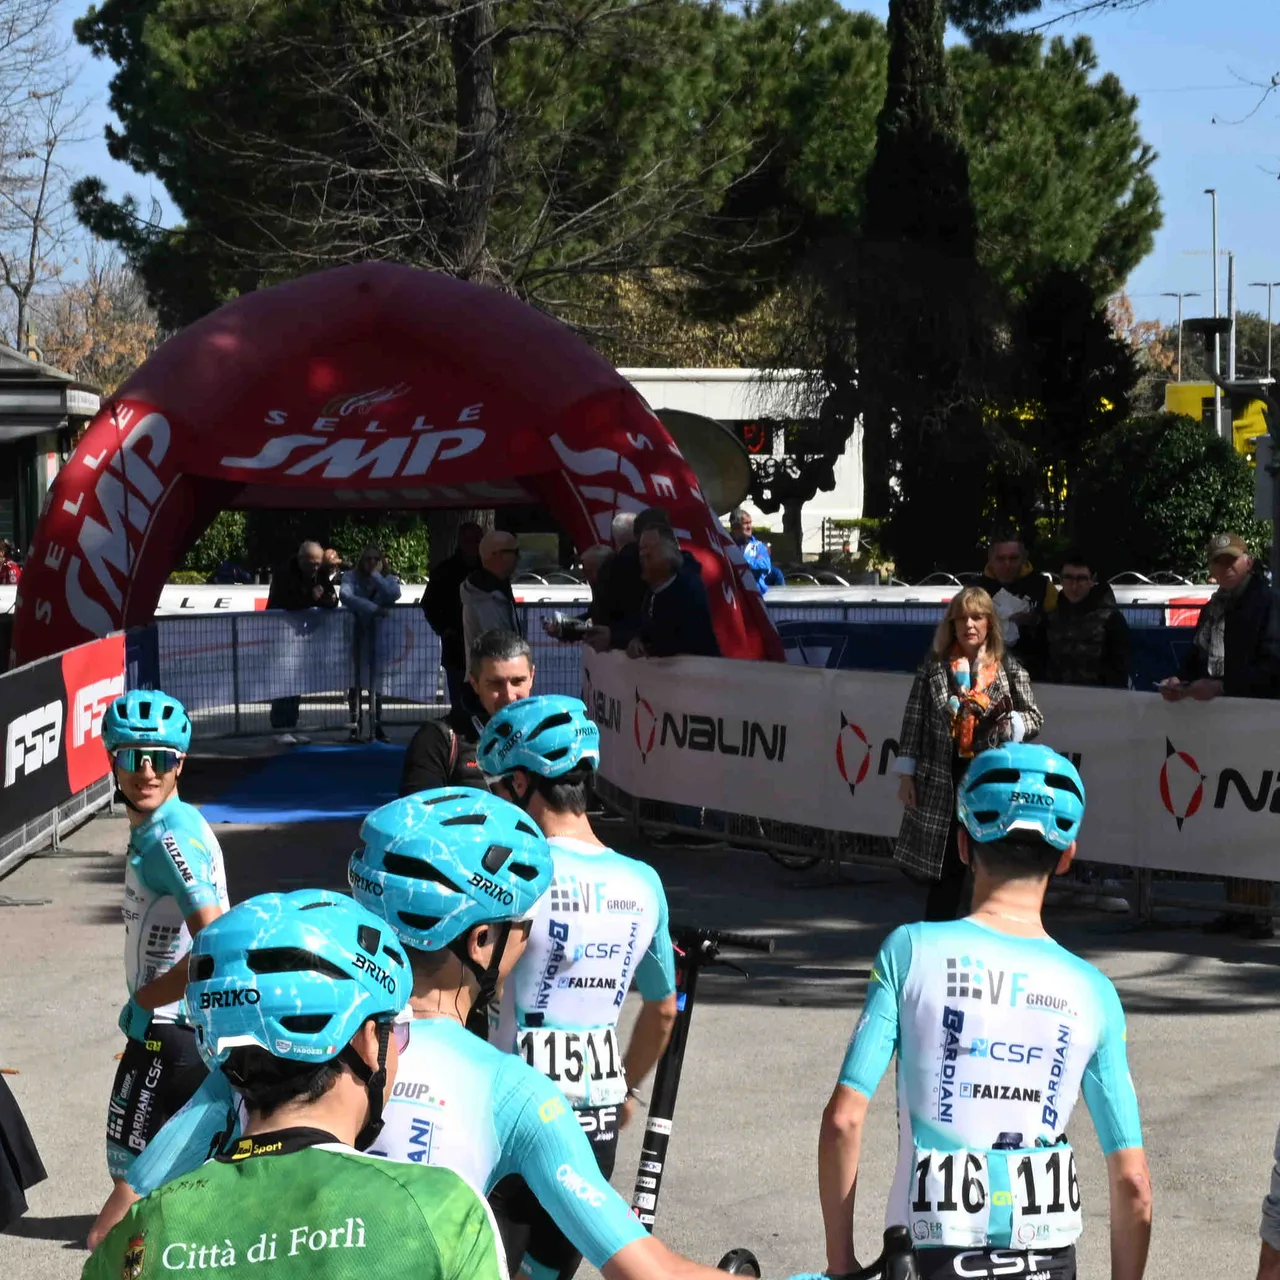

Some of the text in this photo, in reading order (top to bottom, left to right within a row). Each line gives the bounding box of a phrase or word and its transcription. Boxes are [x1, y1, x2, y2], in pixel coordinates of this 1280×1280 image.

[264, 403, 484, 434] SELLE
[220, 428, 486, 479] SMP
[466, 871, 514, 906] BRIKO
[607, 899, 637, 911] GROUP
[536, 919, 570, 1009] BARDIANI
[584, 943, 622, 959] CSF
[352, 952, 397, 995] BRIKO
[200, 988, 261, 1010] BRIKO
[1026, 993, 1068, 1010] GROUP
[521, 1031, 583, 1082] 115
[941, 1005, 965, 1123] BARDIANI
[990, 1041, 1043, 1064] CSF
[145, 1058, 163, 1088] CSF
[1042, 1024, 1070, 1130] BARDIANI
[972, 1083, 1041, 1103] FAIZANE
[574, 1108, 617, 1132] SF
[253, 1141, 283, 1154] Sport
[912, 1153, 985, 1214] 116
[1017, 1152, 1080, 1216] 116
[162, 1217, 367, 1270] Città di Forlì
[953, 1250, 1052, 1278] CSF
